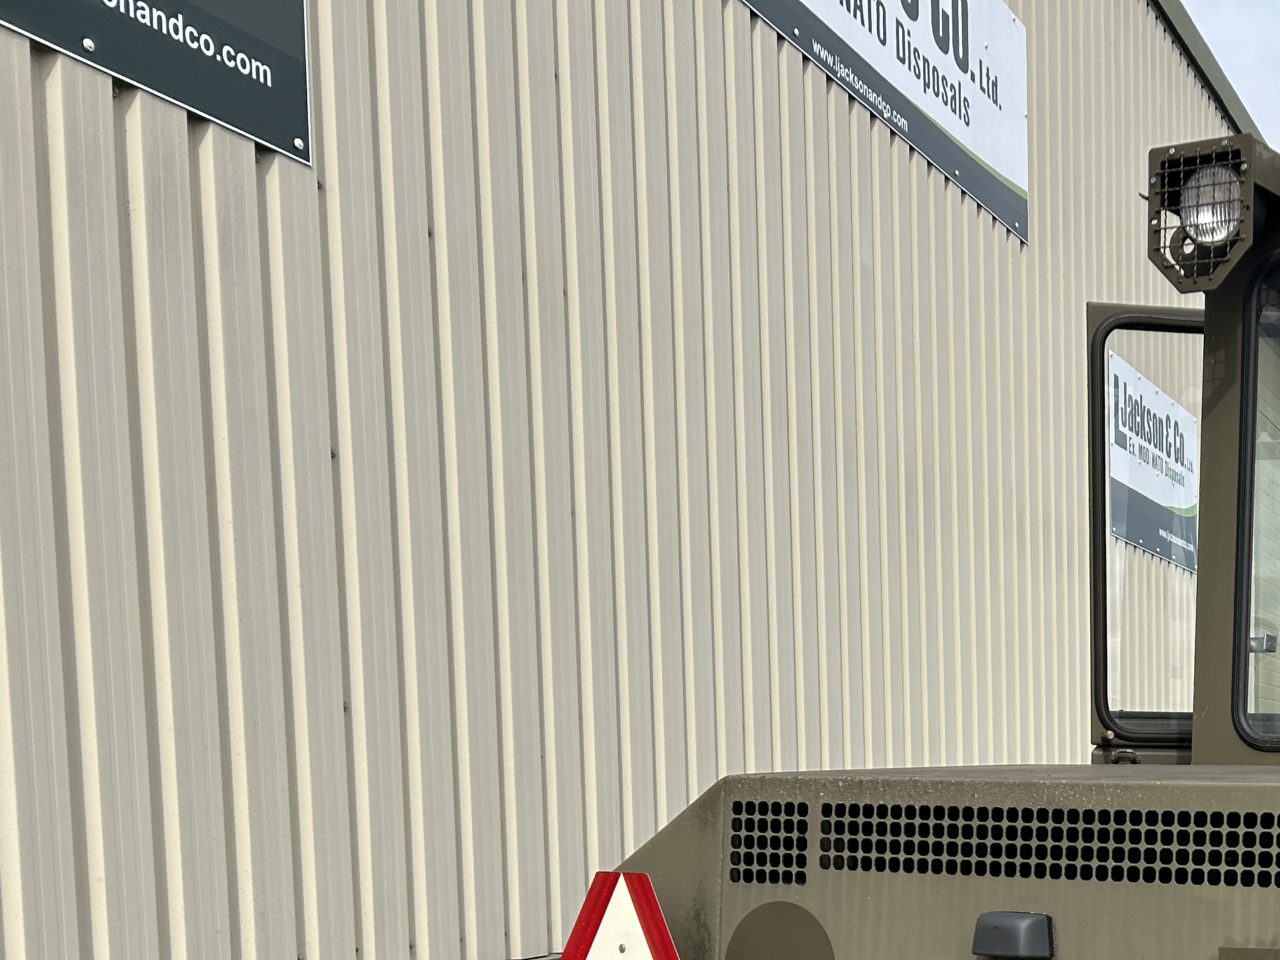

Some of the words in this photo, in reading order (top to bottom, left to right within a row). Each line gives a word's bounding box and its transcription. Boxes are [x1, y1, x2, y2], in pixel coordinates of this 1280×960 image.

[895, 16, 971, 128] Disposals
[978, 58, 1002, 111] Ltd.
[1120, 381, 1164, 454] Jackson
[1165, 413, 1172, 459] &
[1173, 419, 1187, 468] Co.
